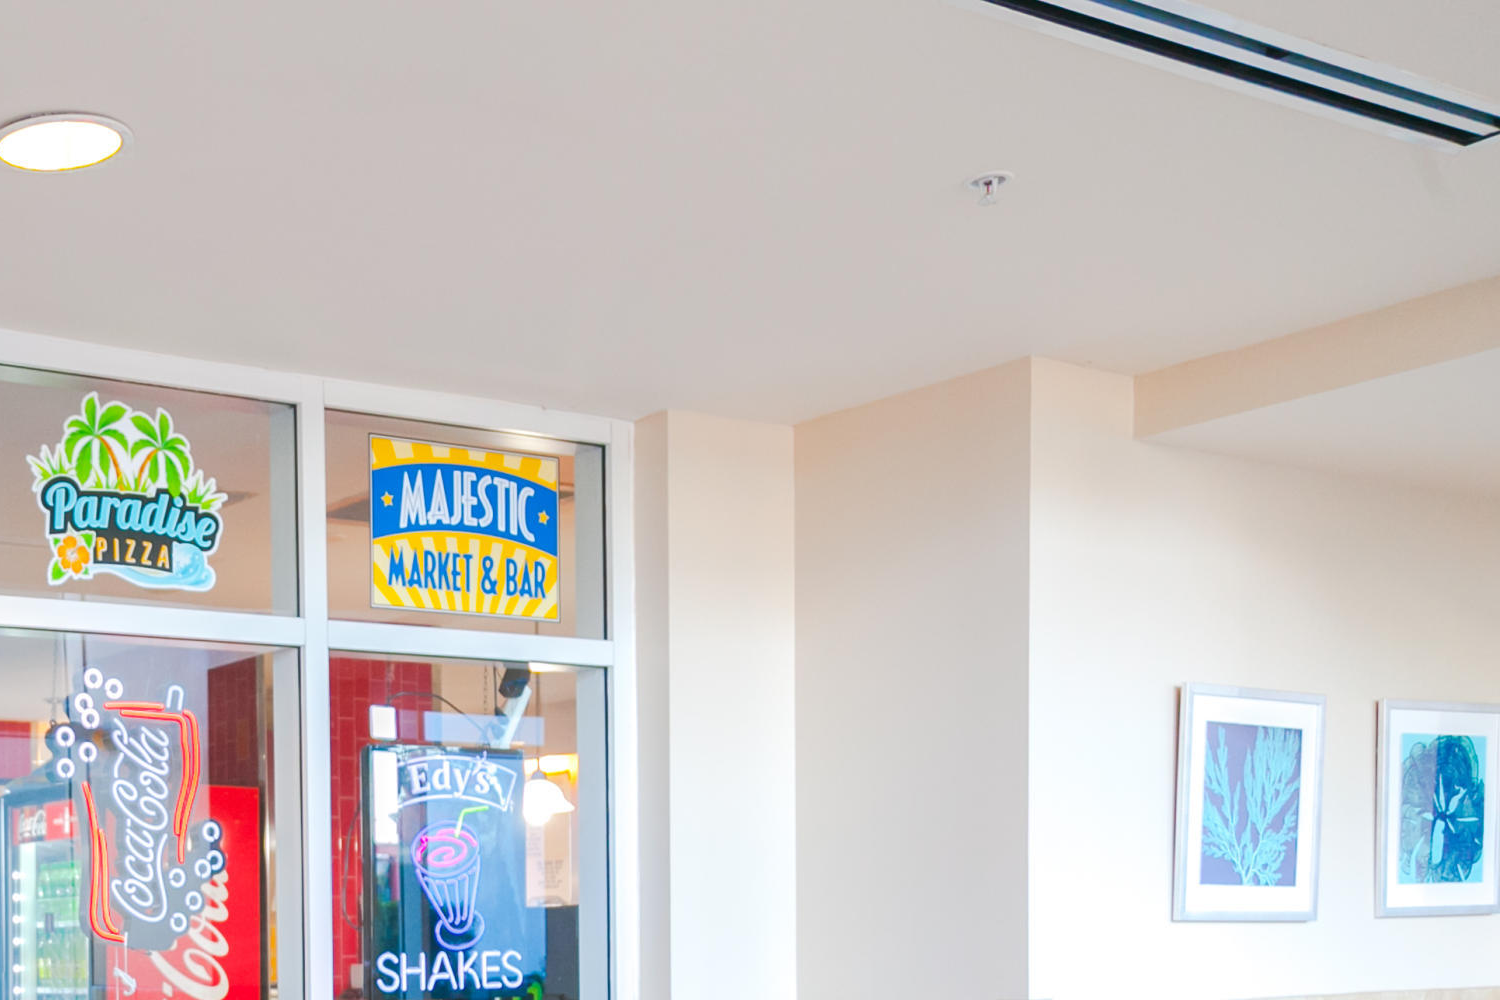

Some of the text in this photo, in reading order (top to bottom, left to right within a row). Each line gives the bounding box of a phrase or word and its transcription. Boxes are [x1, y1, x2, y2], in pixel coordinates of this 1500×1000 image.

[45, 481, 217, 548] Paradise
[399, 468, 536, 543] MAJESTIC
[95, 536, 170, 569] PIZZA
[388, 545, 546, 599] MARKET & BAR
[406, 757, 493, 798] Edy's
[376, 950, 523, 993] SHAKES
